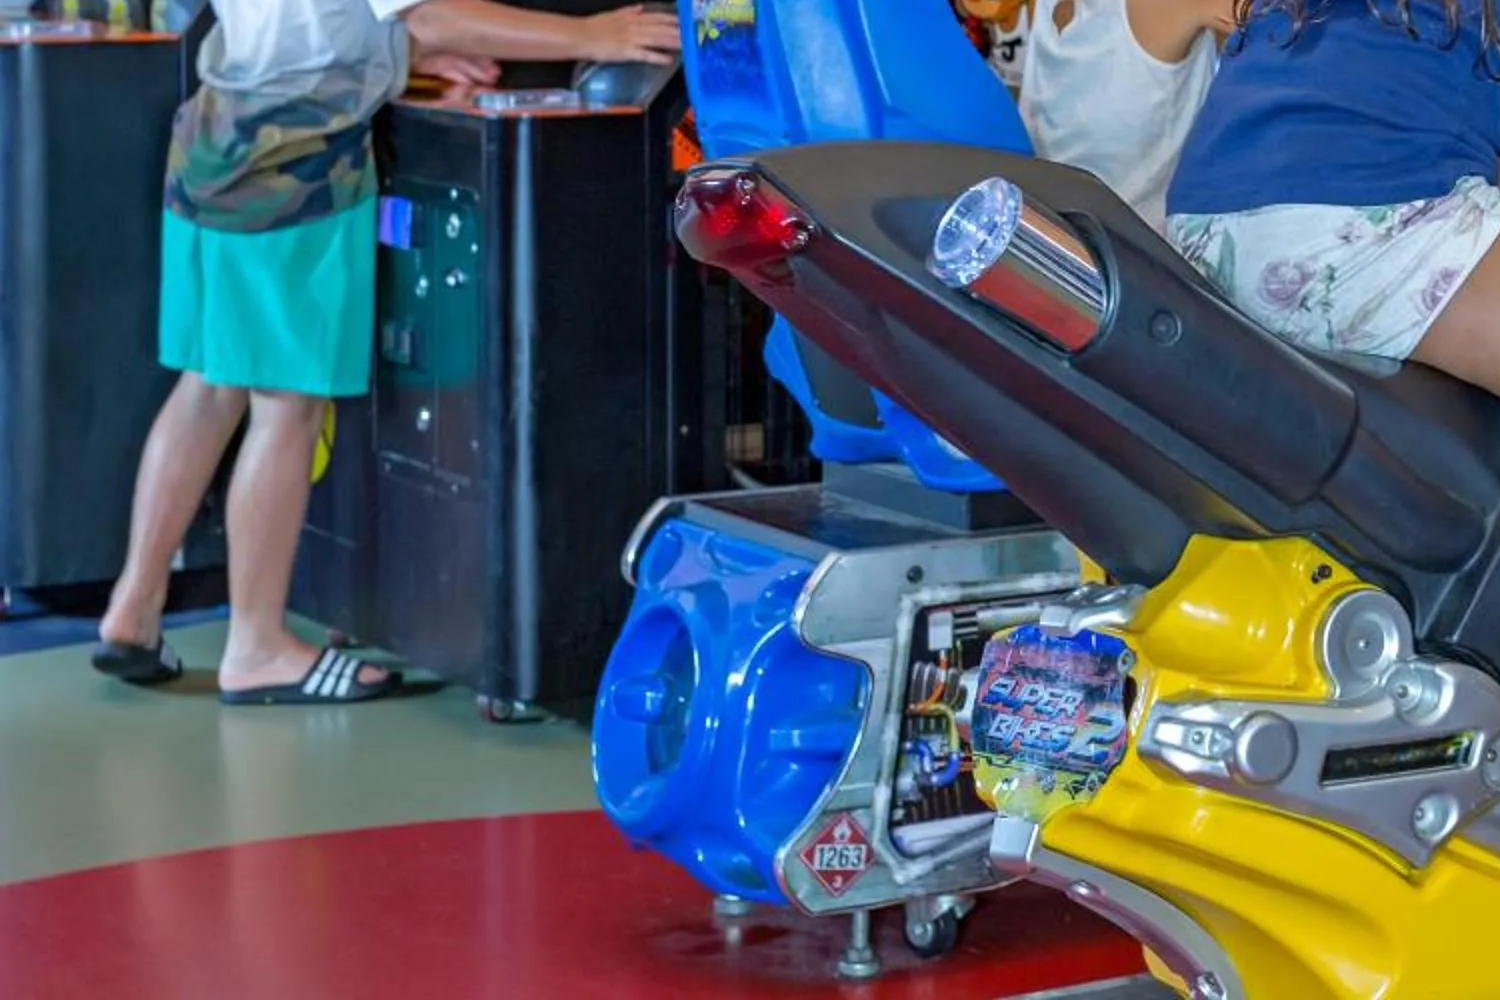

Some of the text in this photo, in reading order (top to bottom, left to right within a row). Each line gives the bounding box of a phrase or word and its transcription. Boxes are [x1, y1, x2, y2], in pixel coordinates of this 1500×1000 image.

[984, 677, 1083, 715] SUPER
[988, 705, 1128, 762] BIKES 2
[819, 846, 862, 868] 1263
